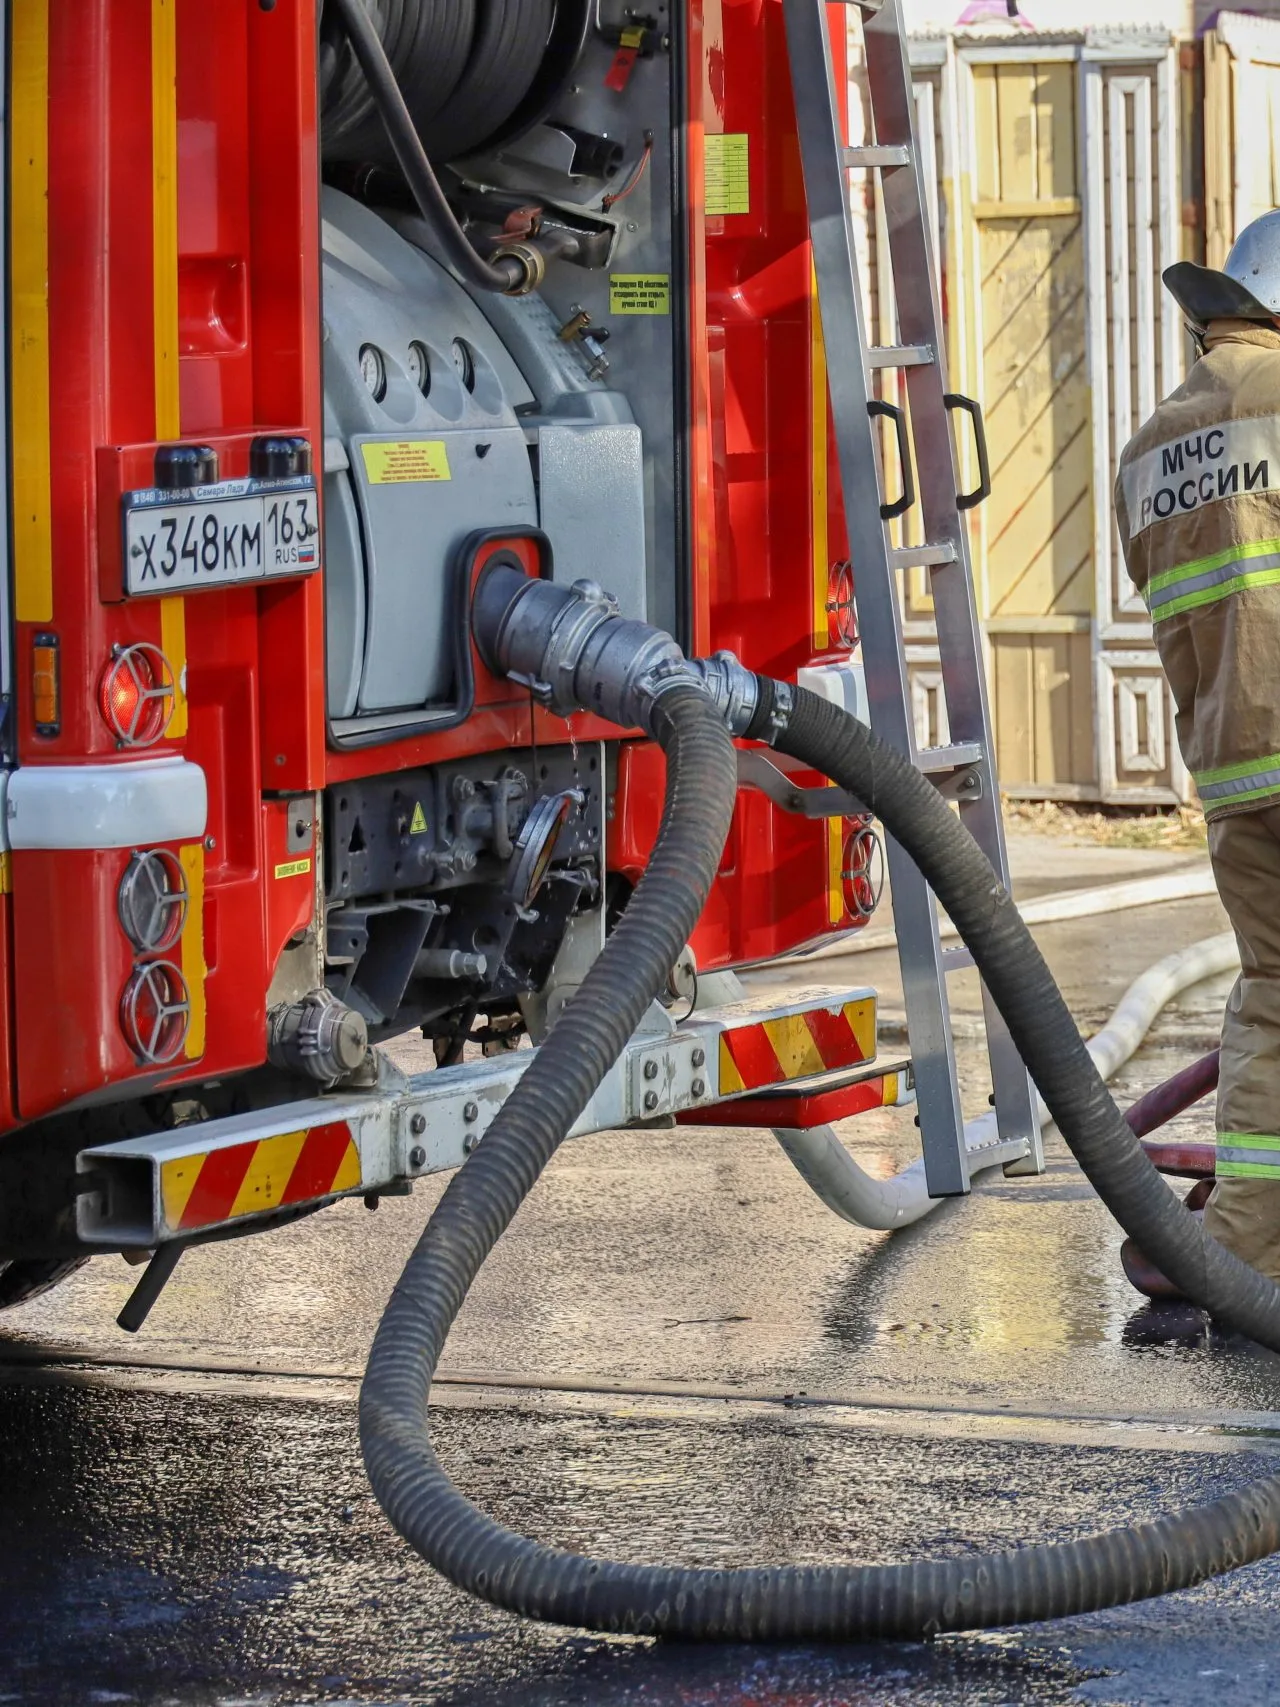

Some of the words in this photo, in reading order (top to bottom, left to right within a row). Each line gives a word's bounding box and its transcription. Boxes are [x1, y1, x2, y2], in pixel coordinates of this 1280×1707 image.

[1162, 429, 1225, 477] МЧС
[197, 486, 225, 498] Самара
[226, 484, 244, 494] Лада
[1141, 460, 1269, 527] РОССИИ
[268, 498, 309, 546] 163
[275, 547, 297, 565] RUS
